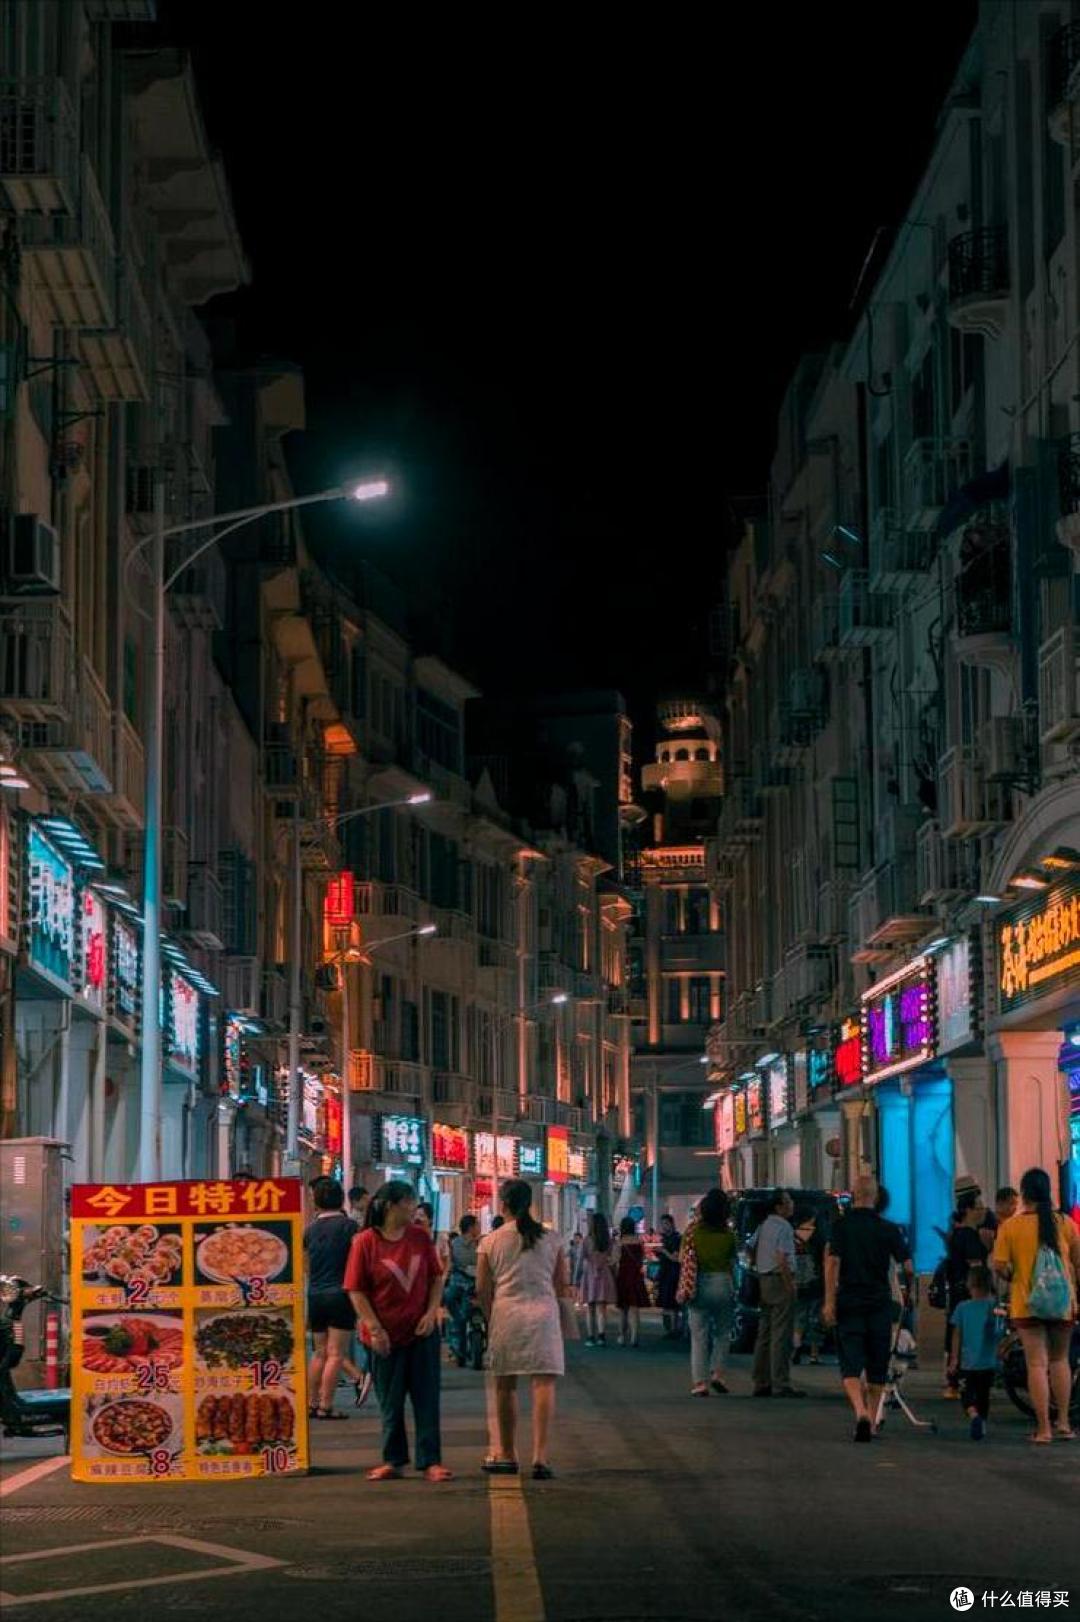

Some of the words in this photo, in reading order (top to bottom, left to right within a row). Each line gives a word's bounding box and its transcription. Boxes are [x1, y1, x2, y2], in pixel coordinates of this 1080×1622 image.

[86, 1181, 287, 1217] 今日特价
[128, 1279, 148, 1304] 2
[248, 1277, 266, 1301] 3
[138, 1364, 170, 1389] 25
[249, 1361, 281, 1387] 12
[153, 1448, 171, 1474] 8
[261, 1445, 289, 1472] 10
